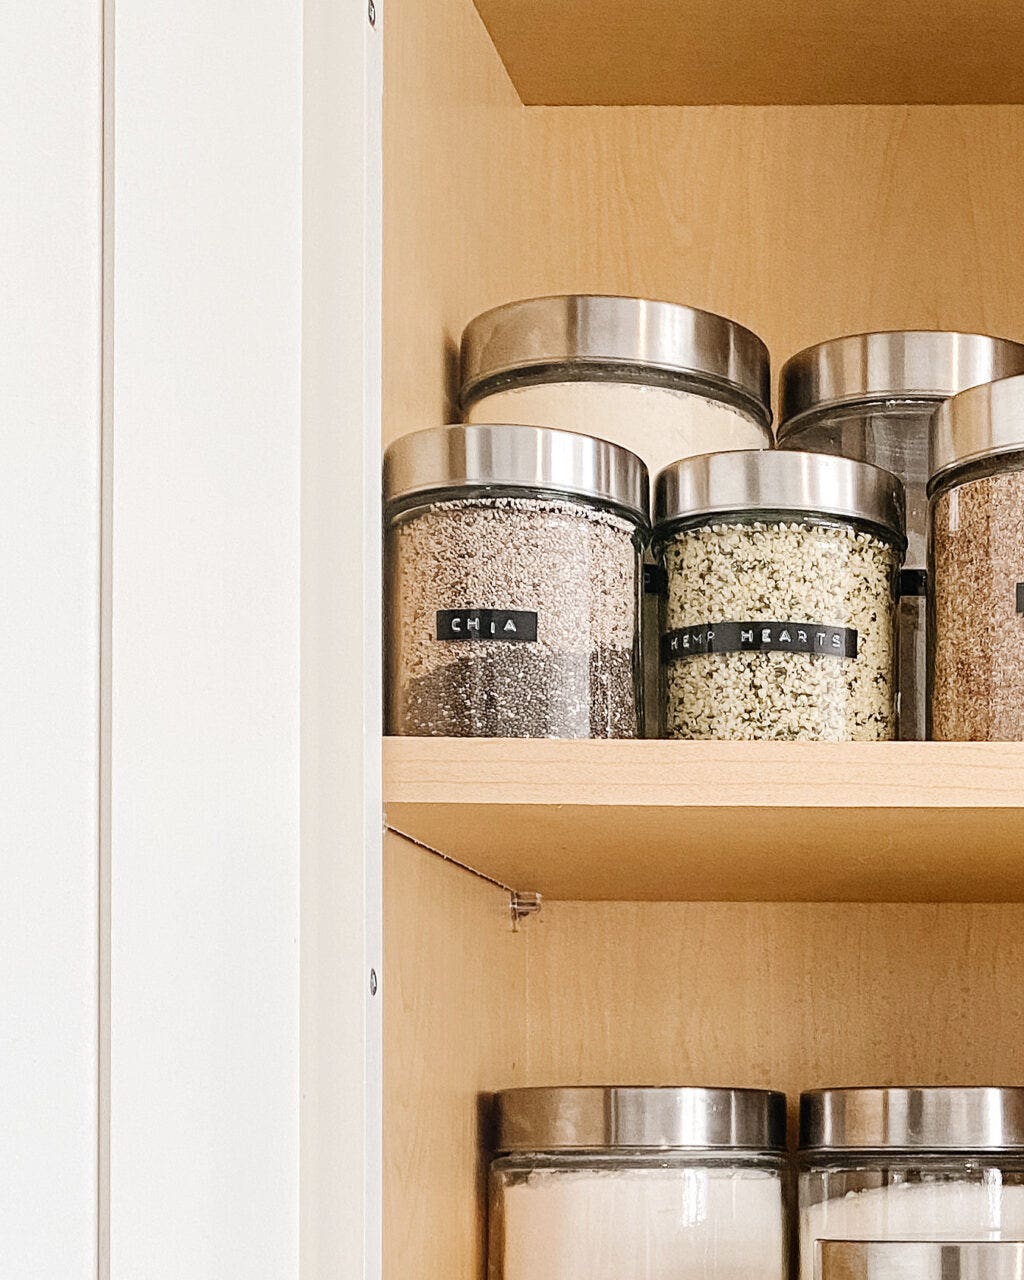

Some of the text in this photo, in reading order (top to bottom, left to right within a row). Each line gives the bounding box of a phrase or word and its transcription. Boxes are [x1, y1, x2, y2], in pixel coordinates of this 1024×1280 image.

[450, 617, 517, 634] CHIA
[670, 628, 842, 650] HEMP HEARTS
